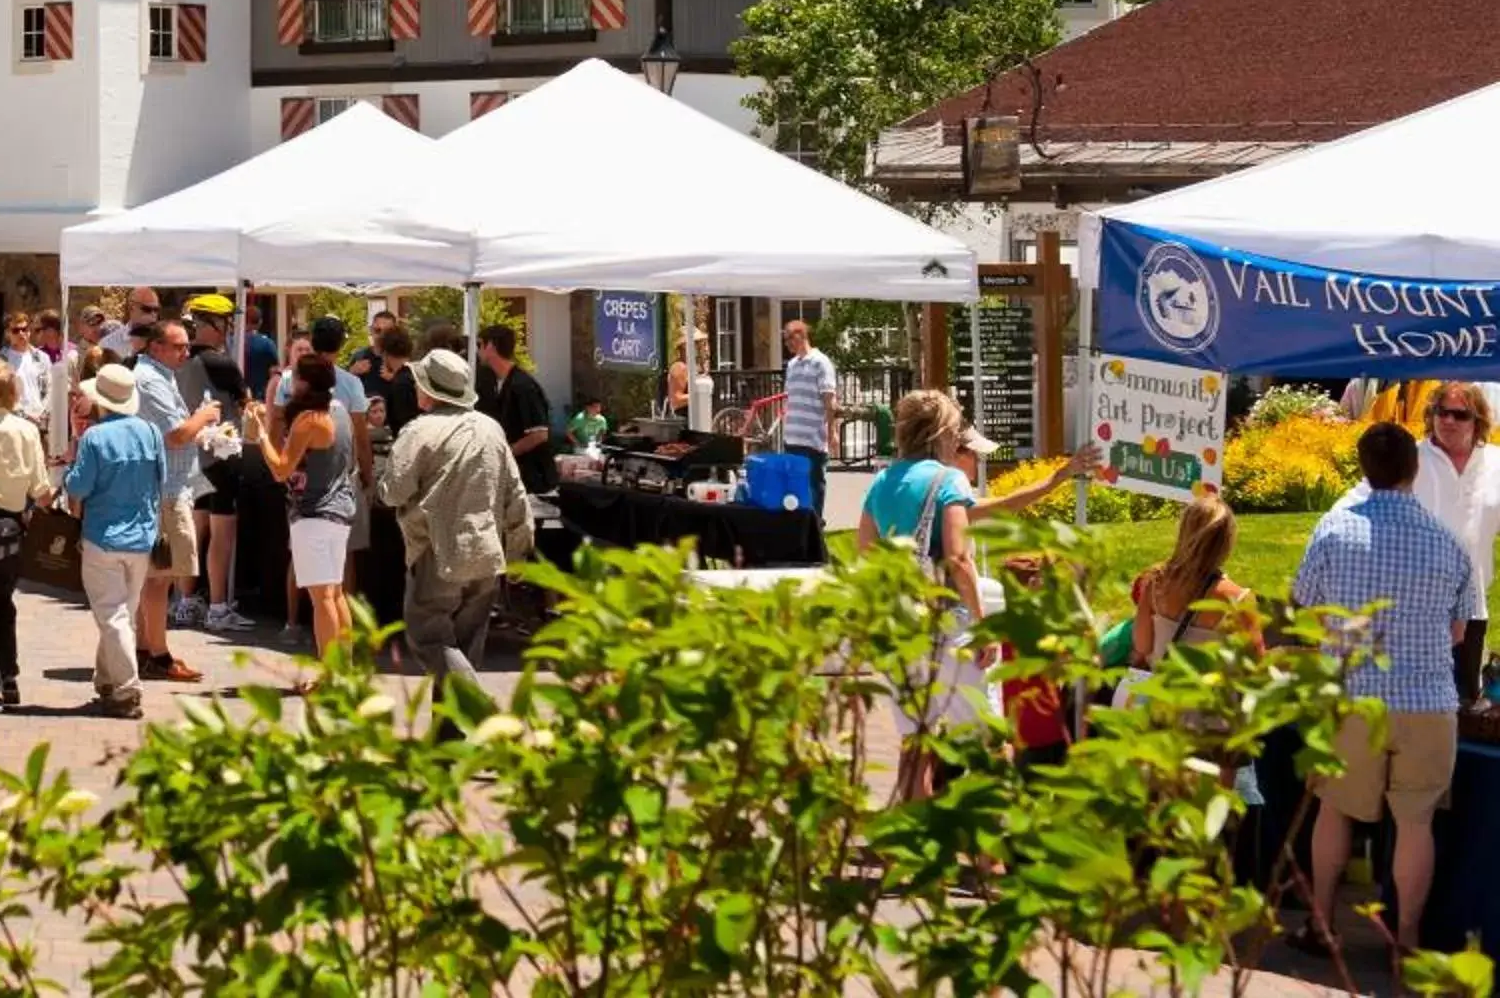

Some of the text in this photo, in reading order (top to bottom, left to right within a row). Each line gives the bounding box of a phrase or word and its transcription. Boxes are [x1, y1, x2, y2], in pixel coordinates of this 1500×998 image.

[1222, 258, 1310, 308] VAIL
[1324, 272, 1496, 318] MOUNT
[612, 338, 641, 357] CART
[1352, 323, 1497, 358] HOME
[1100, 361, 1221, 413] Cmmunity
